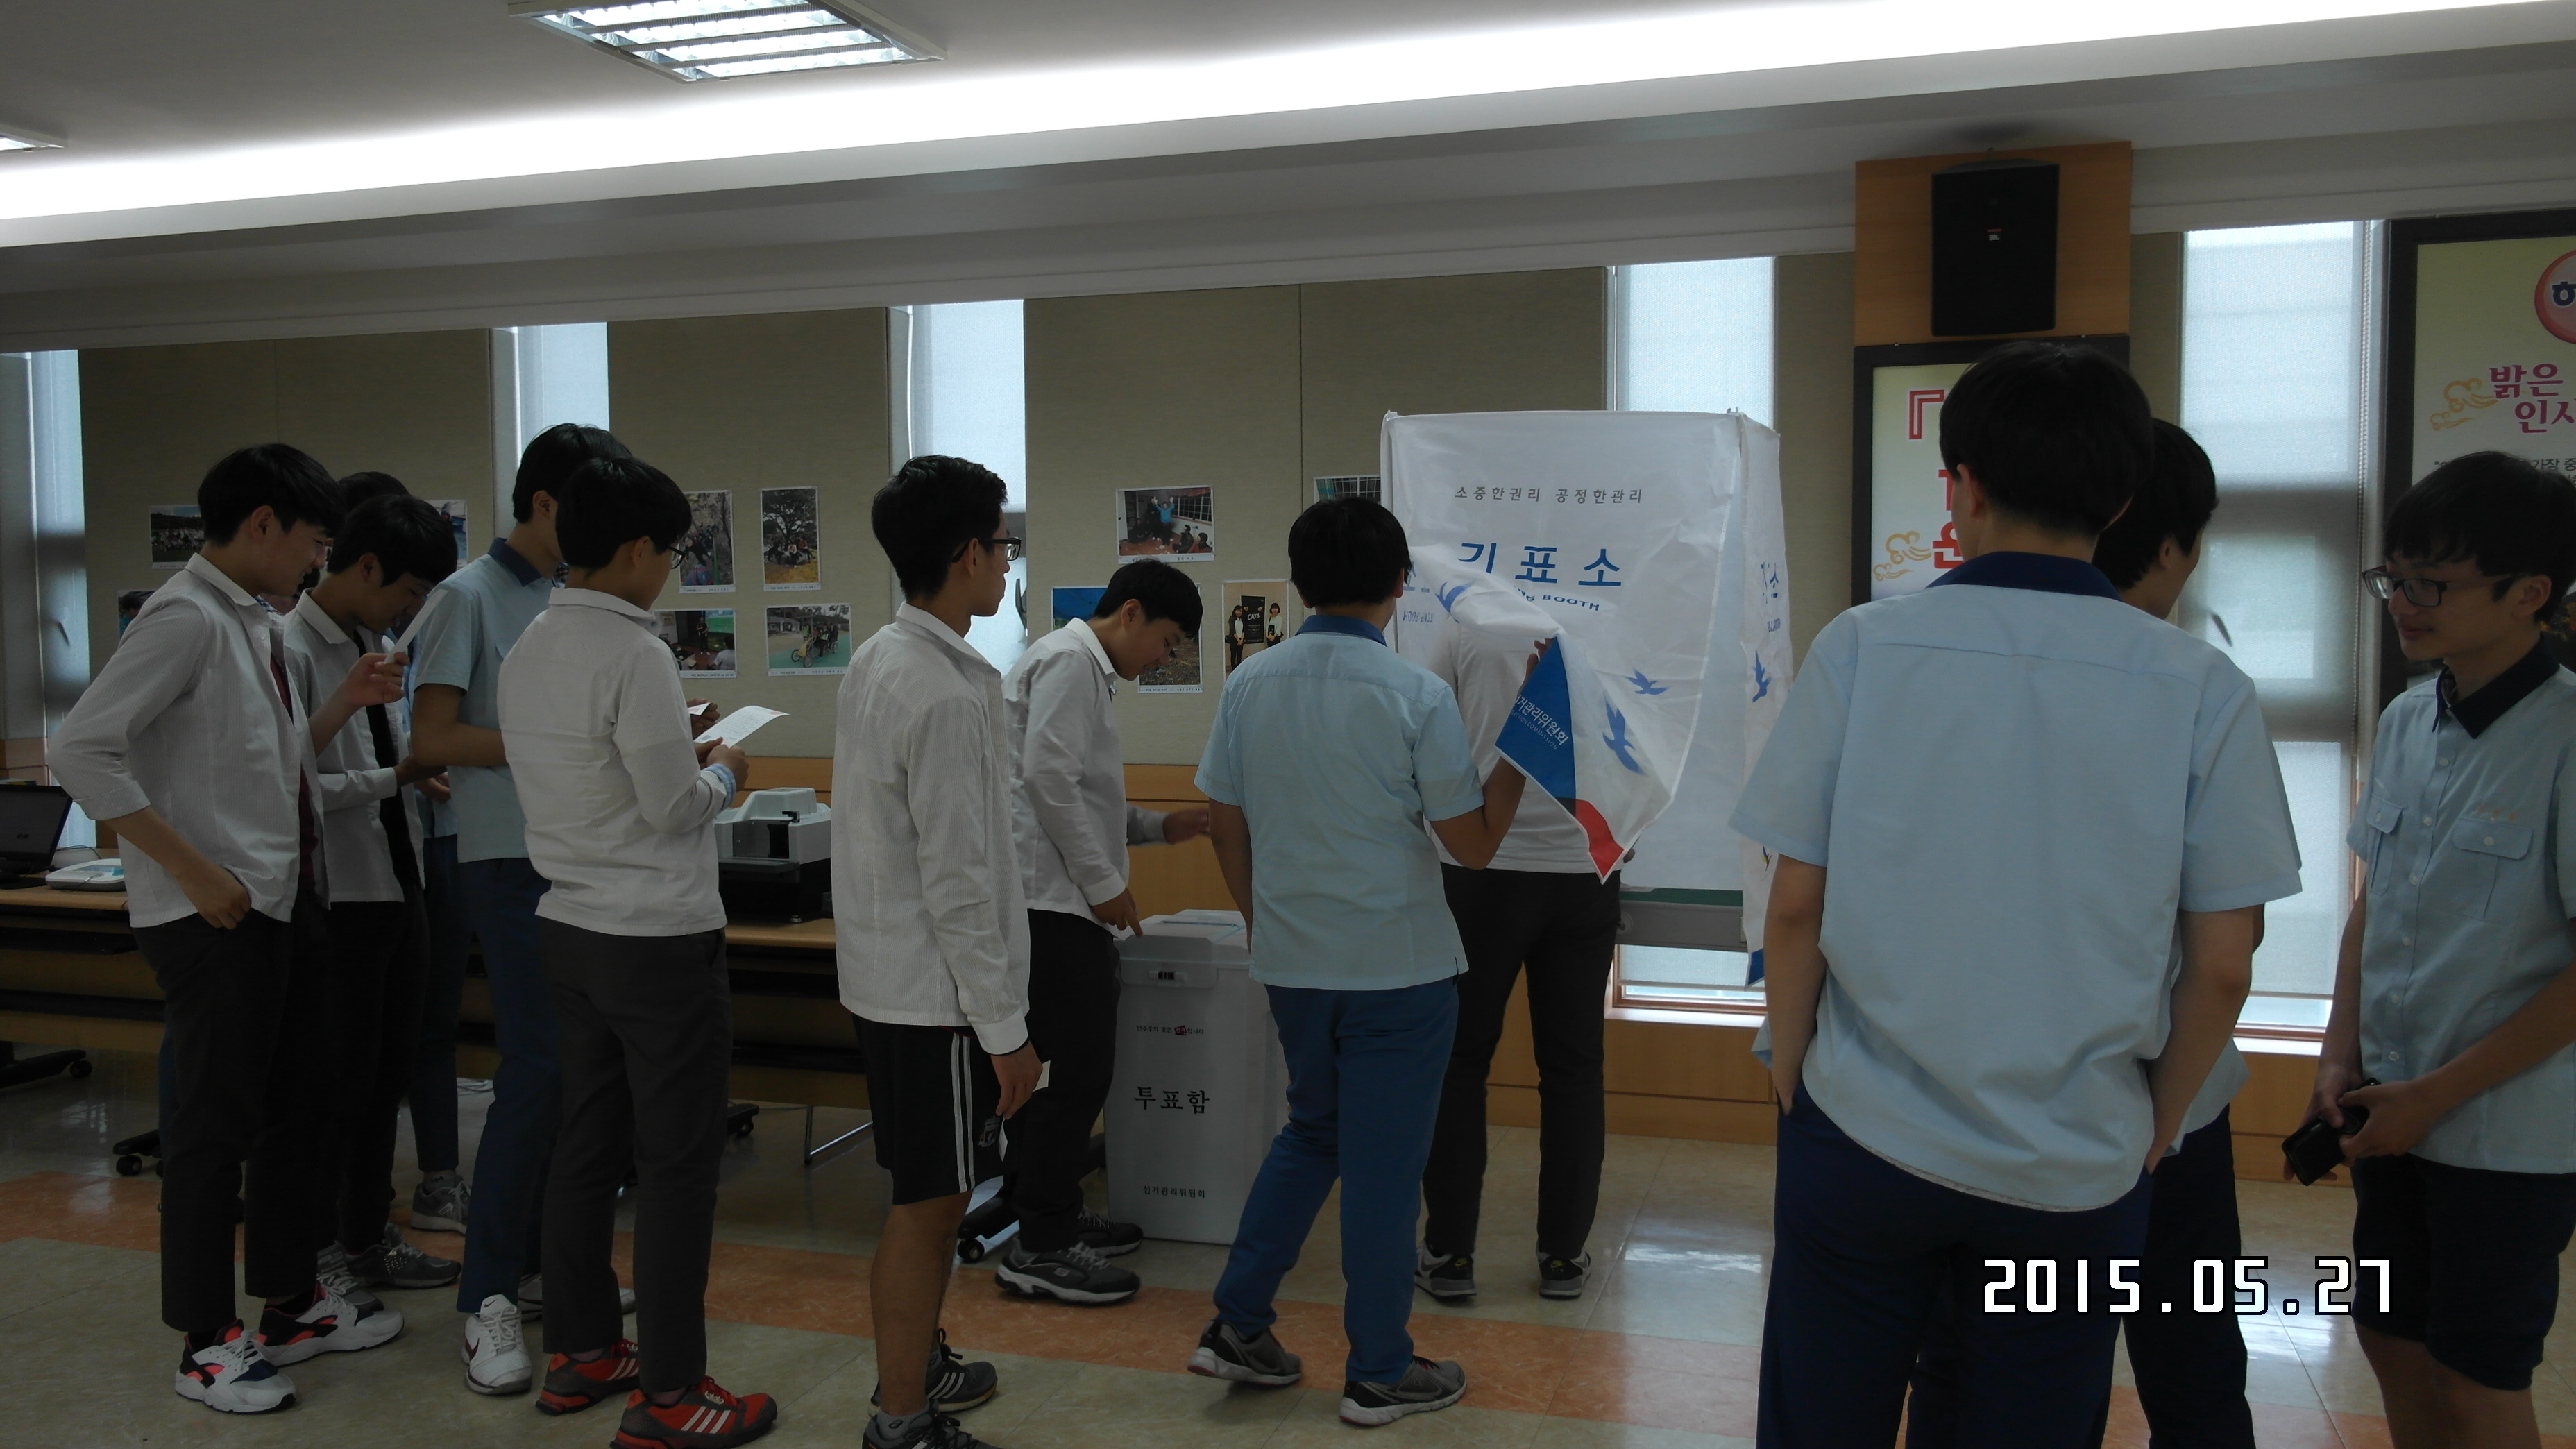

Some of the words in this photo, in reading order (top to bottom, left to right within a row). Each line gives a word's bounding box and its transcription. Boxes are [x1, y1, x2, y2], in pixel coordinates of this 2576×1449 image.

[2489, 363, 2564, 399] 밝은
[1455, 486, 1541, 502] 소중한권리
[1555, 489, 1642, 504] 공정한관리
[1457, 542, 1622, 587] 기표소
[1542, 594, 1600, 611] BOOTH
[1134, 1086, 1211, 1114] 투표함
